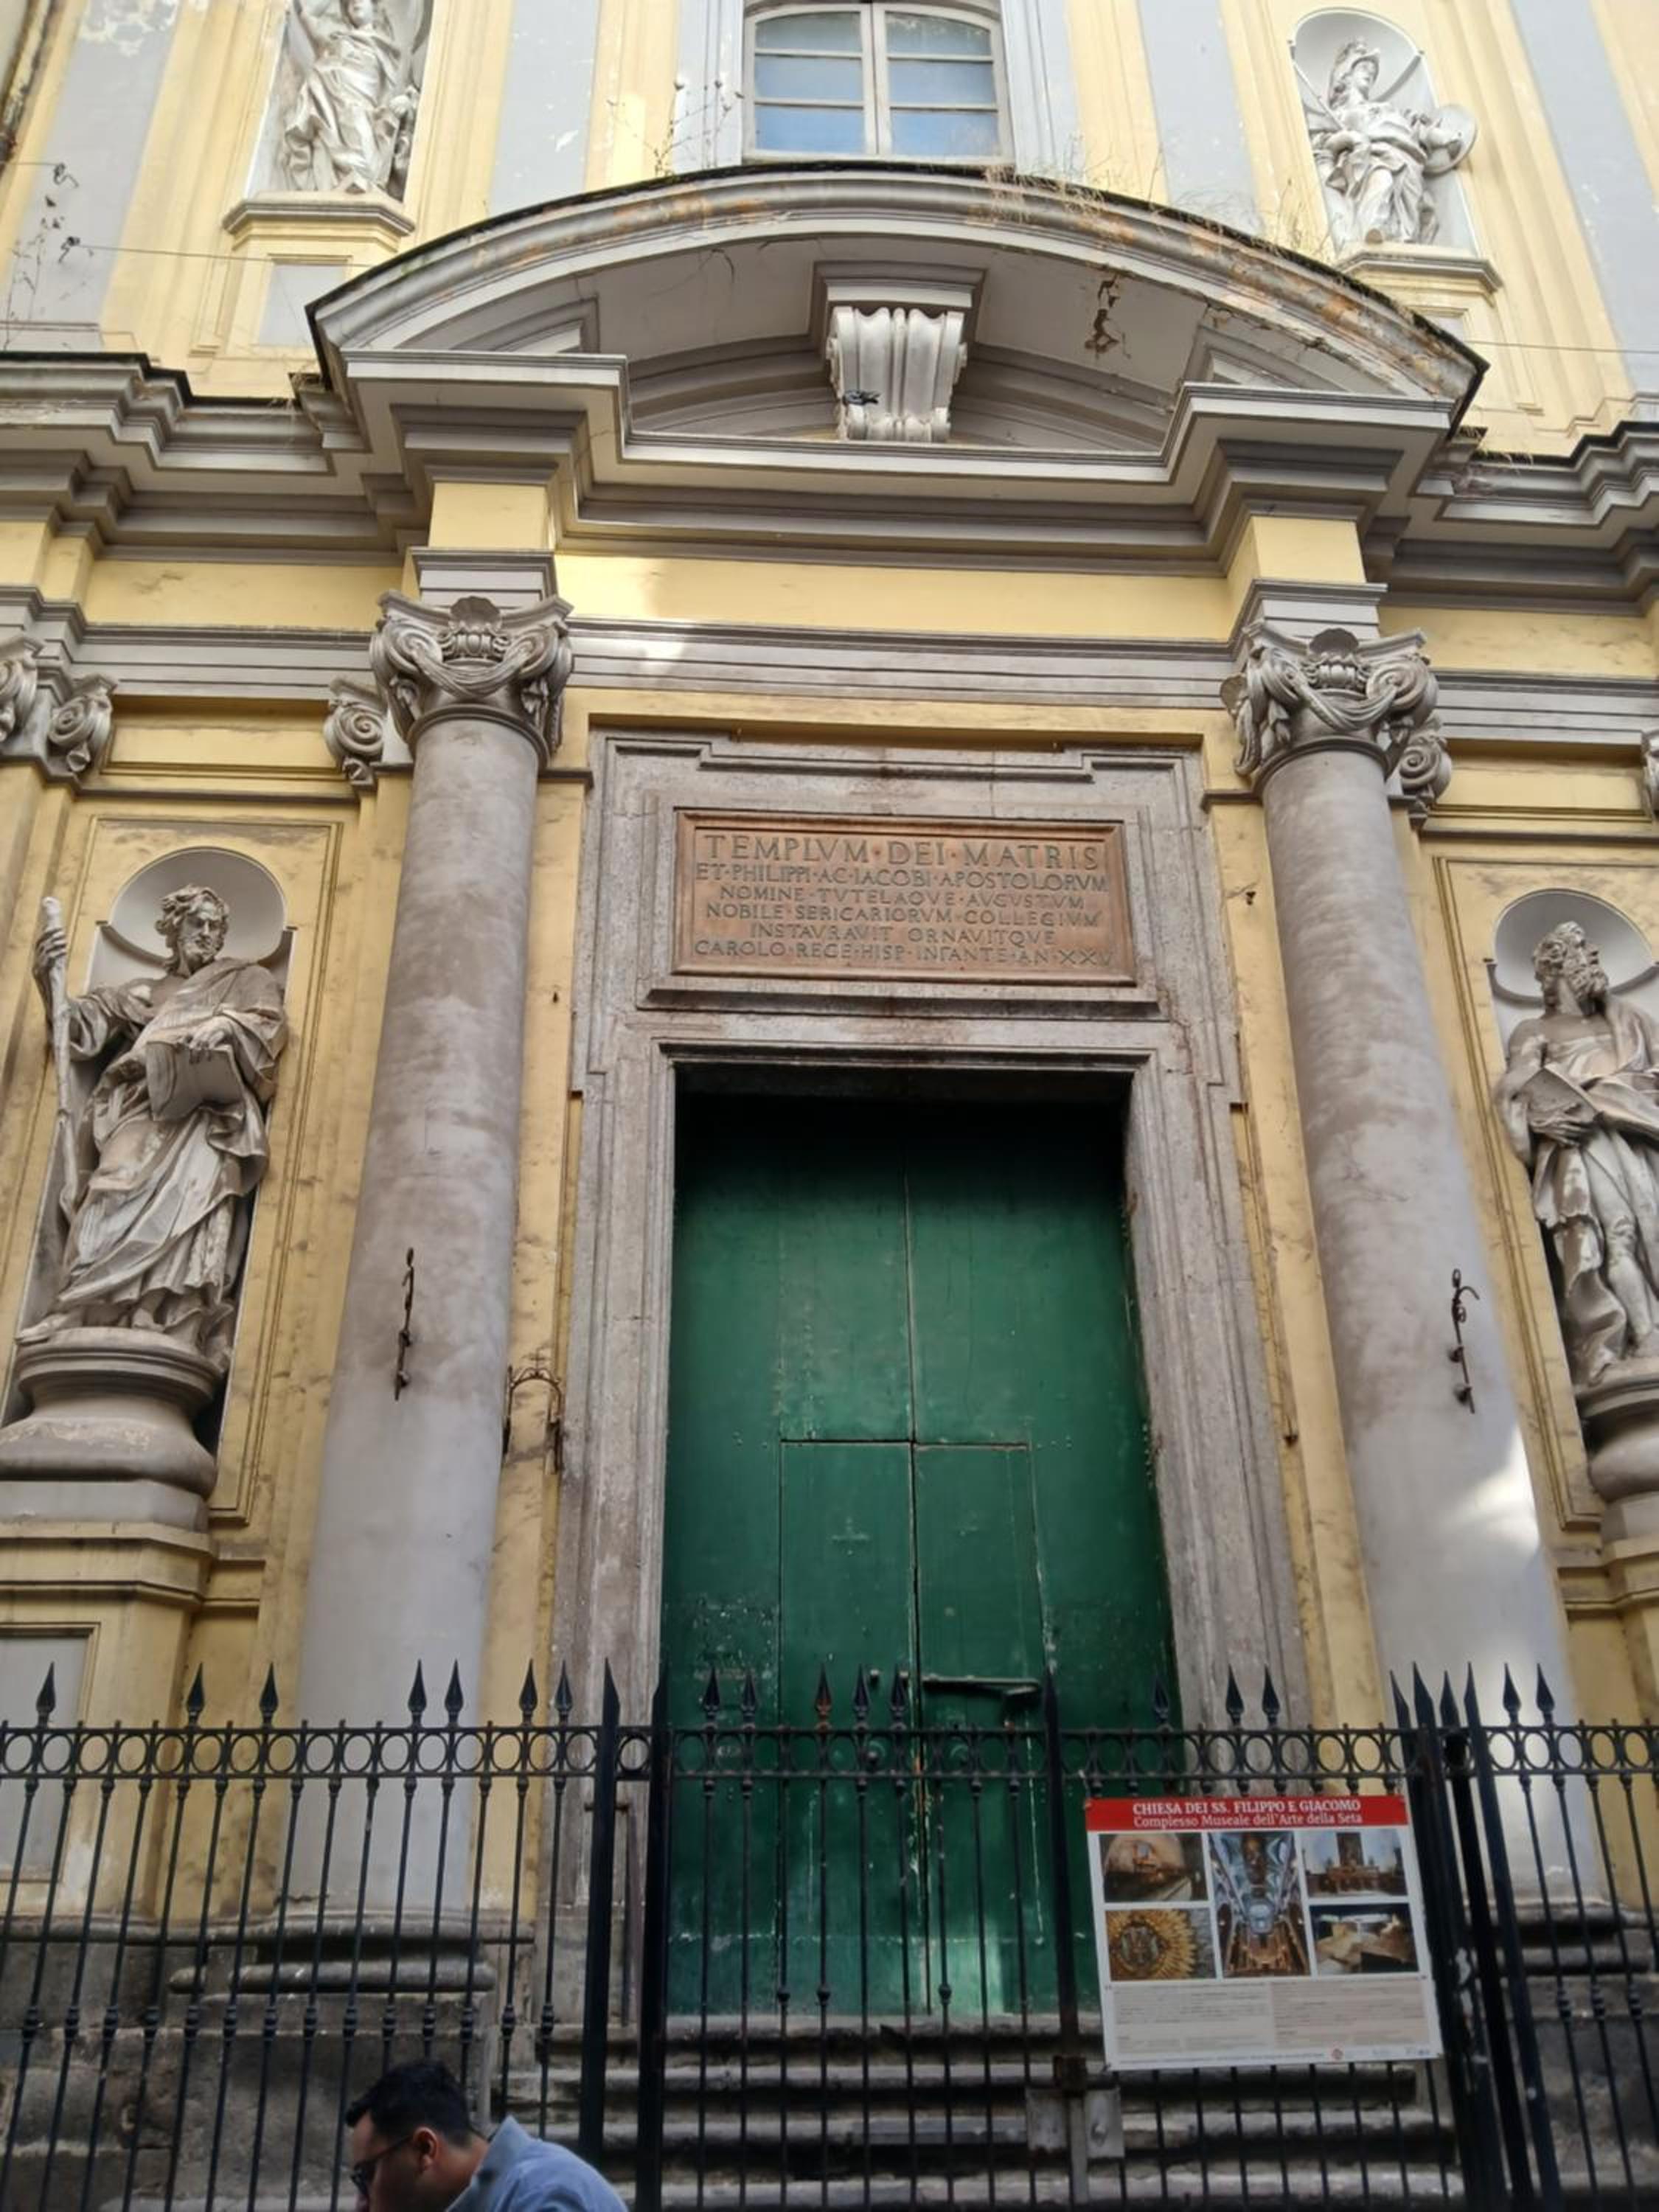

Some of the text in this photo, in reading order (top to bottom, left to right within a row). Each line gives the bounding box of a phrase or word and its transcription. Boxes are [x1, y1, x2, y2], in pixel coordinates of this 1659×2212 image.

[704, 835, 1098, 870] TEMPLVM DEI MATRIS
[695, 862, 725, 880] ET
[818, 868, 847, 884] AC
[720, 886, 804, 902] NOMINE
[706, 903, 785, 919] NOBILE
[794, 905, 953, 925] SERICARIORVM
[908, 928, 1056, 948] ORNAVITQVE
[695, 940, 785, 957] CAROLO
[1133, 1799, 1361, 1815] CHIESA DEI SS. FILIPPO E GIACOMO
[1133, 1816, 1199, 1829] Complesso
[1202, 1815, 1250, 1826] Museale
[1307, 1813, 1335, 1823] della
[1338, 1813, 1363, 1823] Seta
